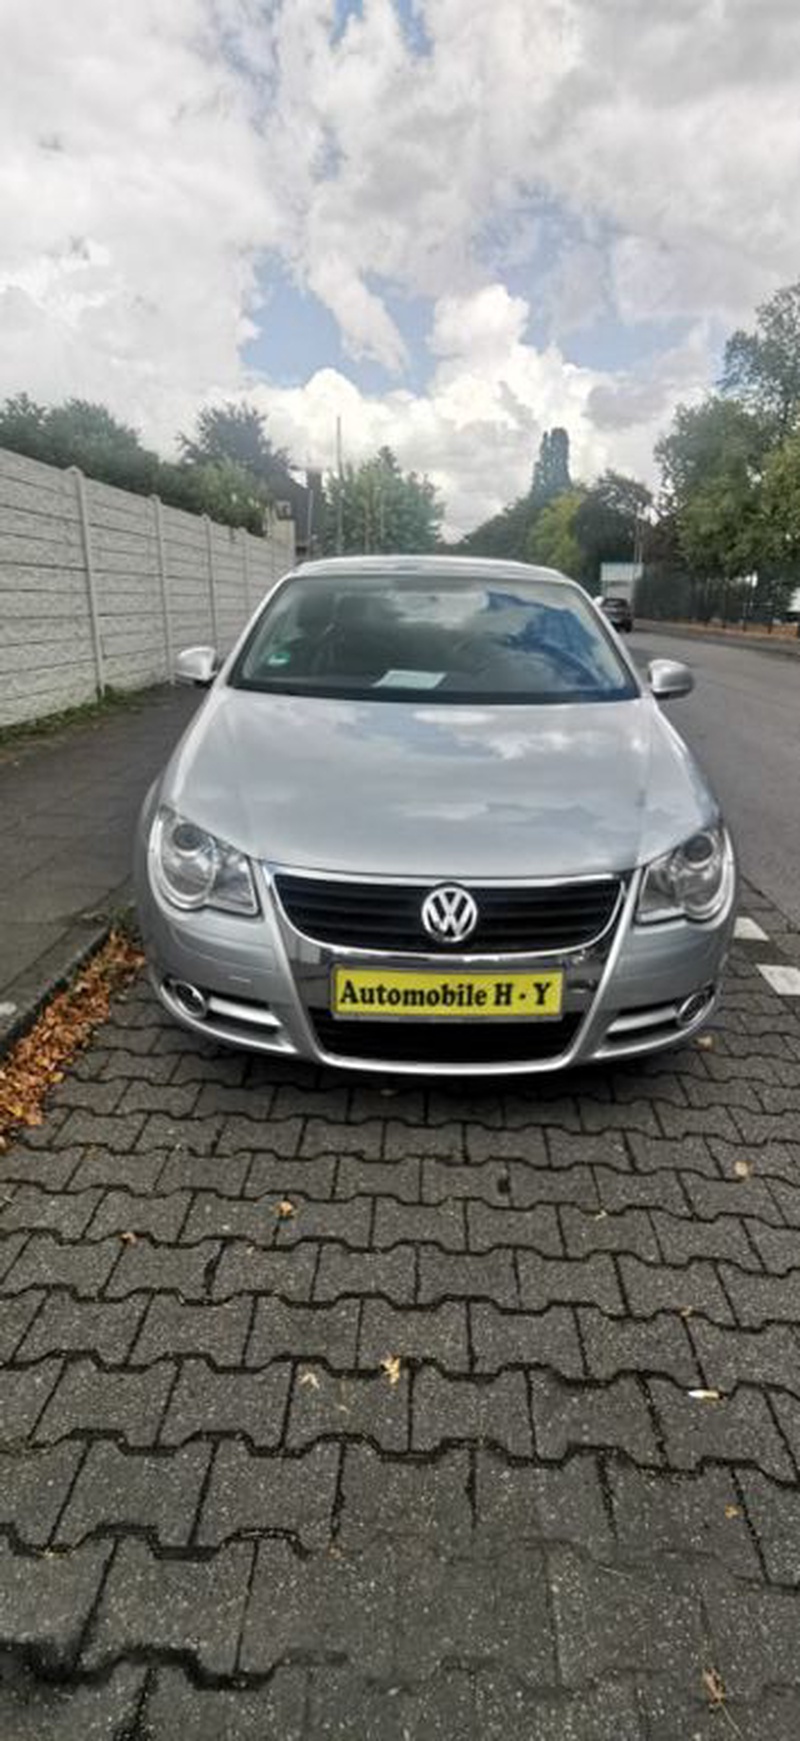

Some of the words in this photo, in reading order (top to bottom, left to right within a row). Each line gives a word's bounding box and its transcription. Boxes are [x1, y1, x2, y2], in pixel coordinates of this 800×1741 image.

[422, 888, 478, 942] VW
[340, 980, 488, 1006] Automobile
[494, 982, 513, 1006] H
[534, 982, 552, 1005] Y
